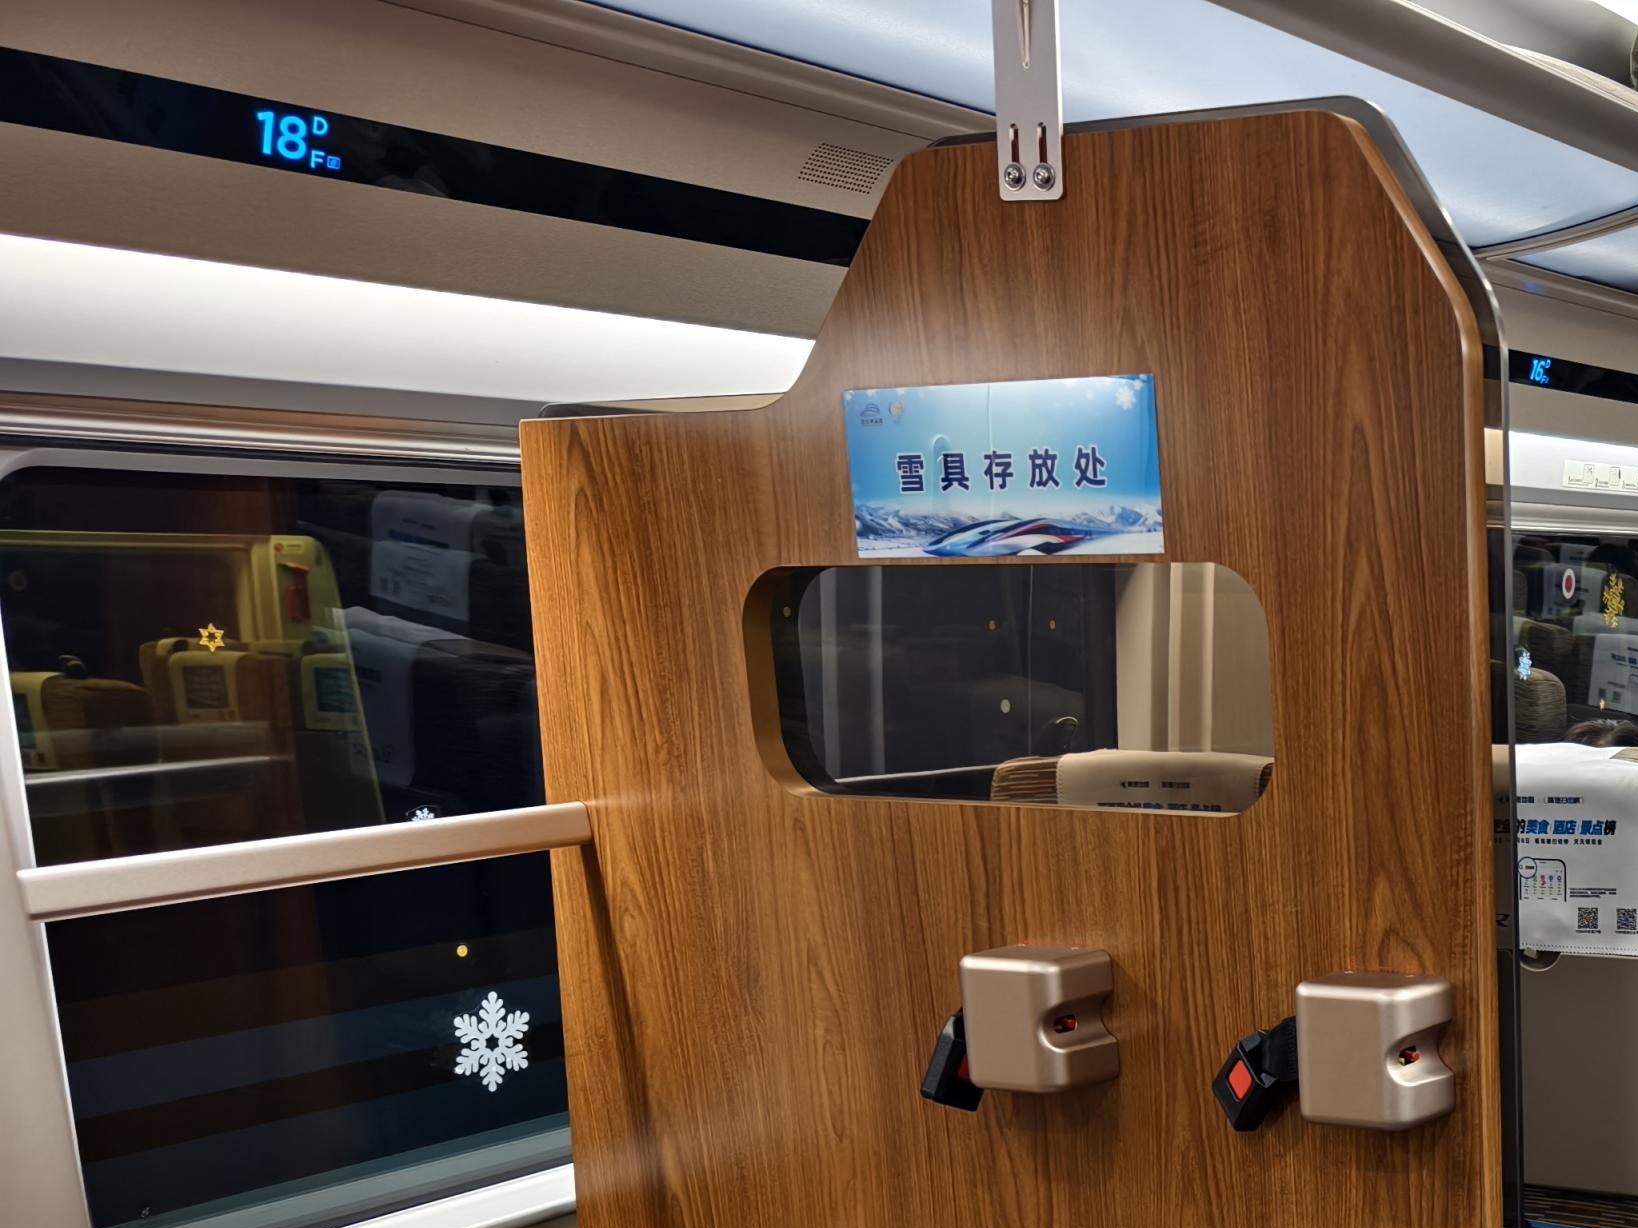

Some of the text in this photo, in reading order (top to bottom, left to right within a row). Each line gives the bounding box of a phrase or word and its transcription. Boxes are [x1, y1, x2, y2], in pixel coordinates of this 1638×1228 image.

[257, 112, 329, 160] 18 D
[310, 150, 325, 168] F
[1530, 359, 1546, 382] 16
[897, 447, 1107, 492] 雪具存放处
